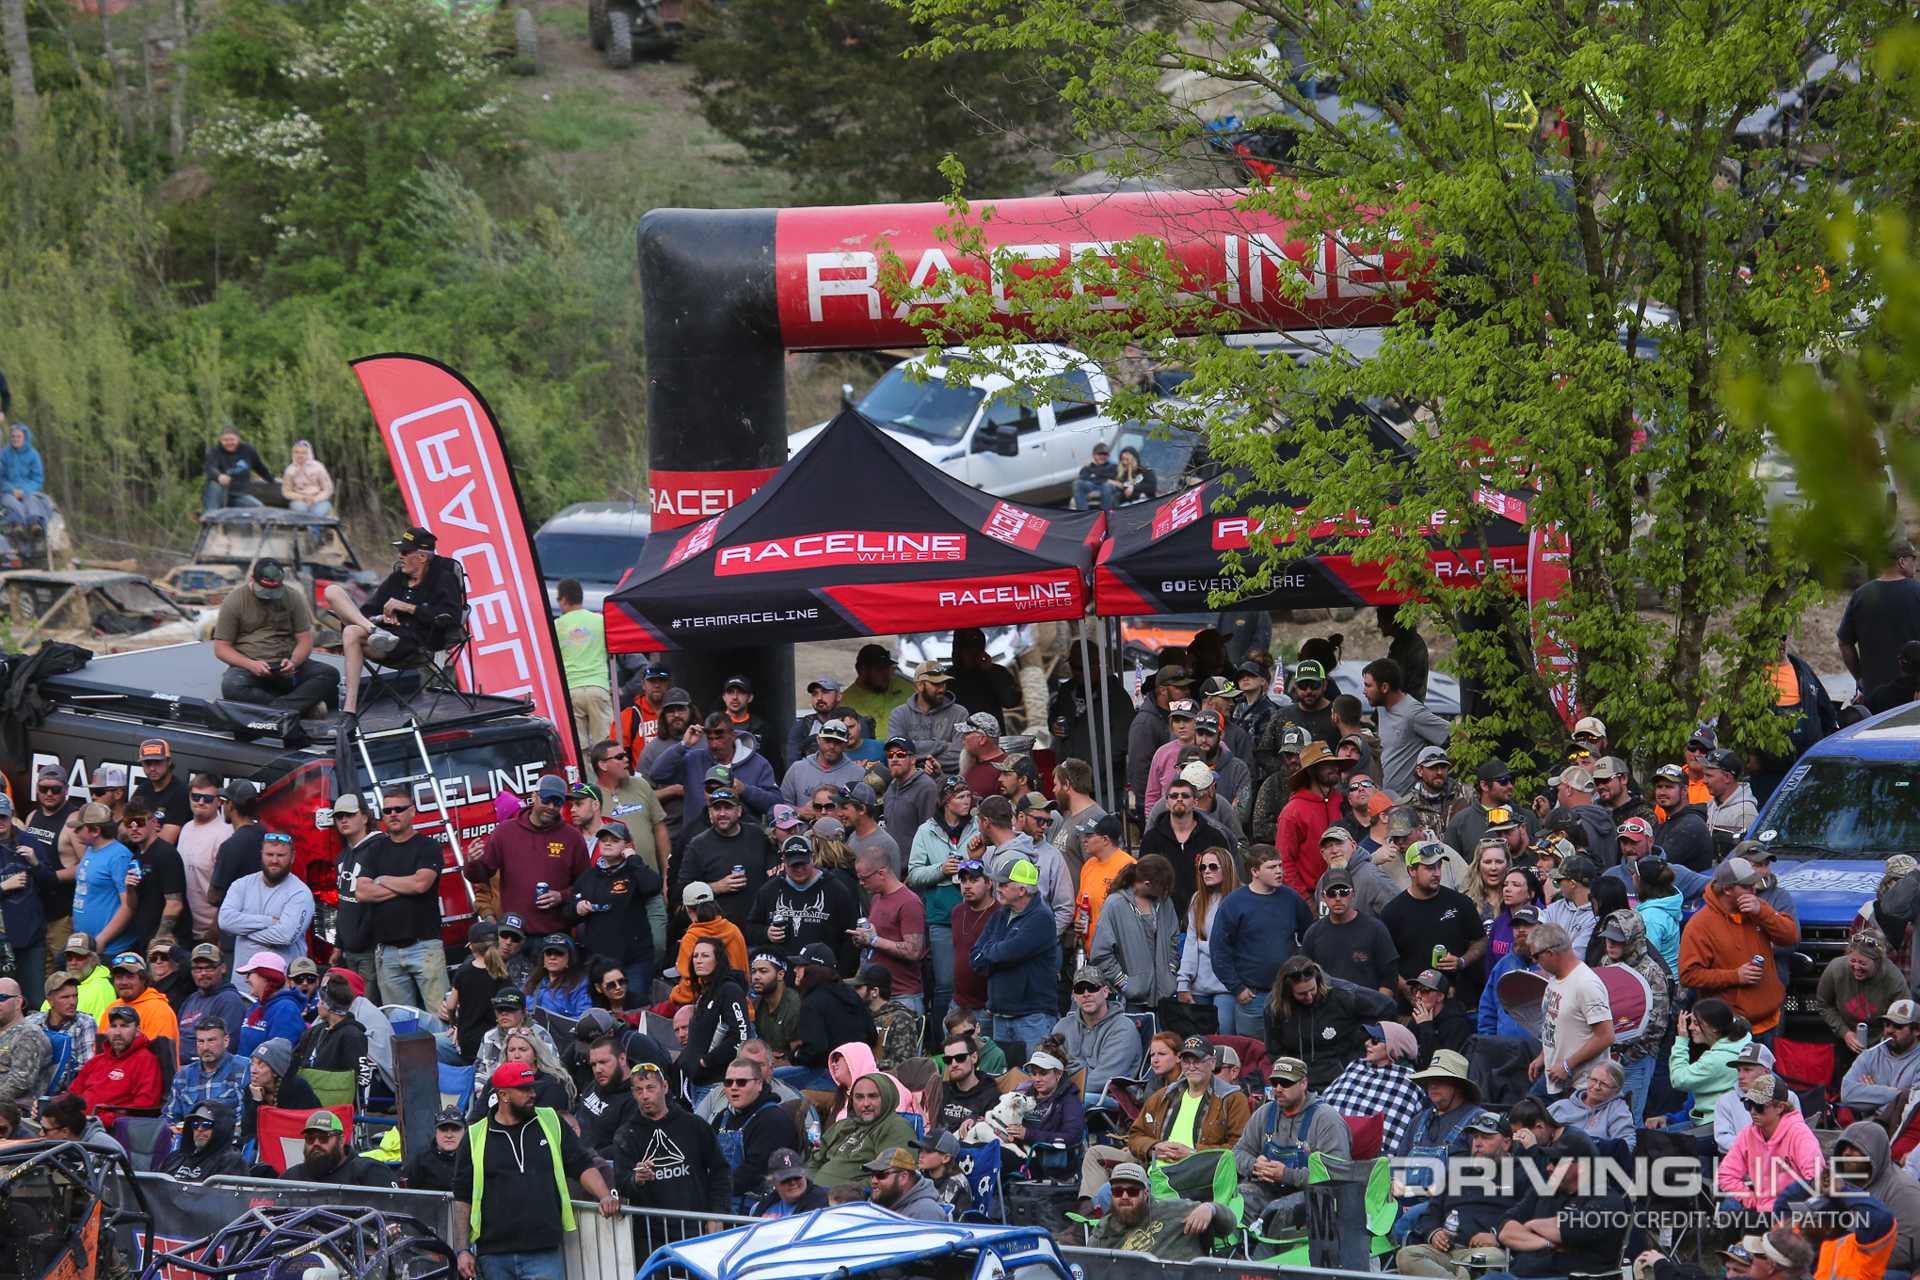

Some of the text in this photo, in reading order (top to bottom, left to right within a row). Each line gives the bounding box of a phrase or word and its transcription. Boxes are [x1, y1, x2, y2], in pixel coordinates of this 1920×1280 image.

[649, 487, 760, 516] RACEL
[720, 534, 961, 566] RACELINE
[856, 551, 961, 562] WHEELS
[939, 581, 1072, 608] RACELINE
[1161, 574, 1306, 593] GOEVERYERE
[1015, 597, 1073, 611] WHEELS
[671, 607, 818, 629] #TEAMRACELINE
[360, 761, 545, 820] RCELINE
[462, 822, 500, 840] SUPP
[769, 909, 831, 921] LEGENDARY
[731, 1001, 749, 1050] carha
